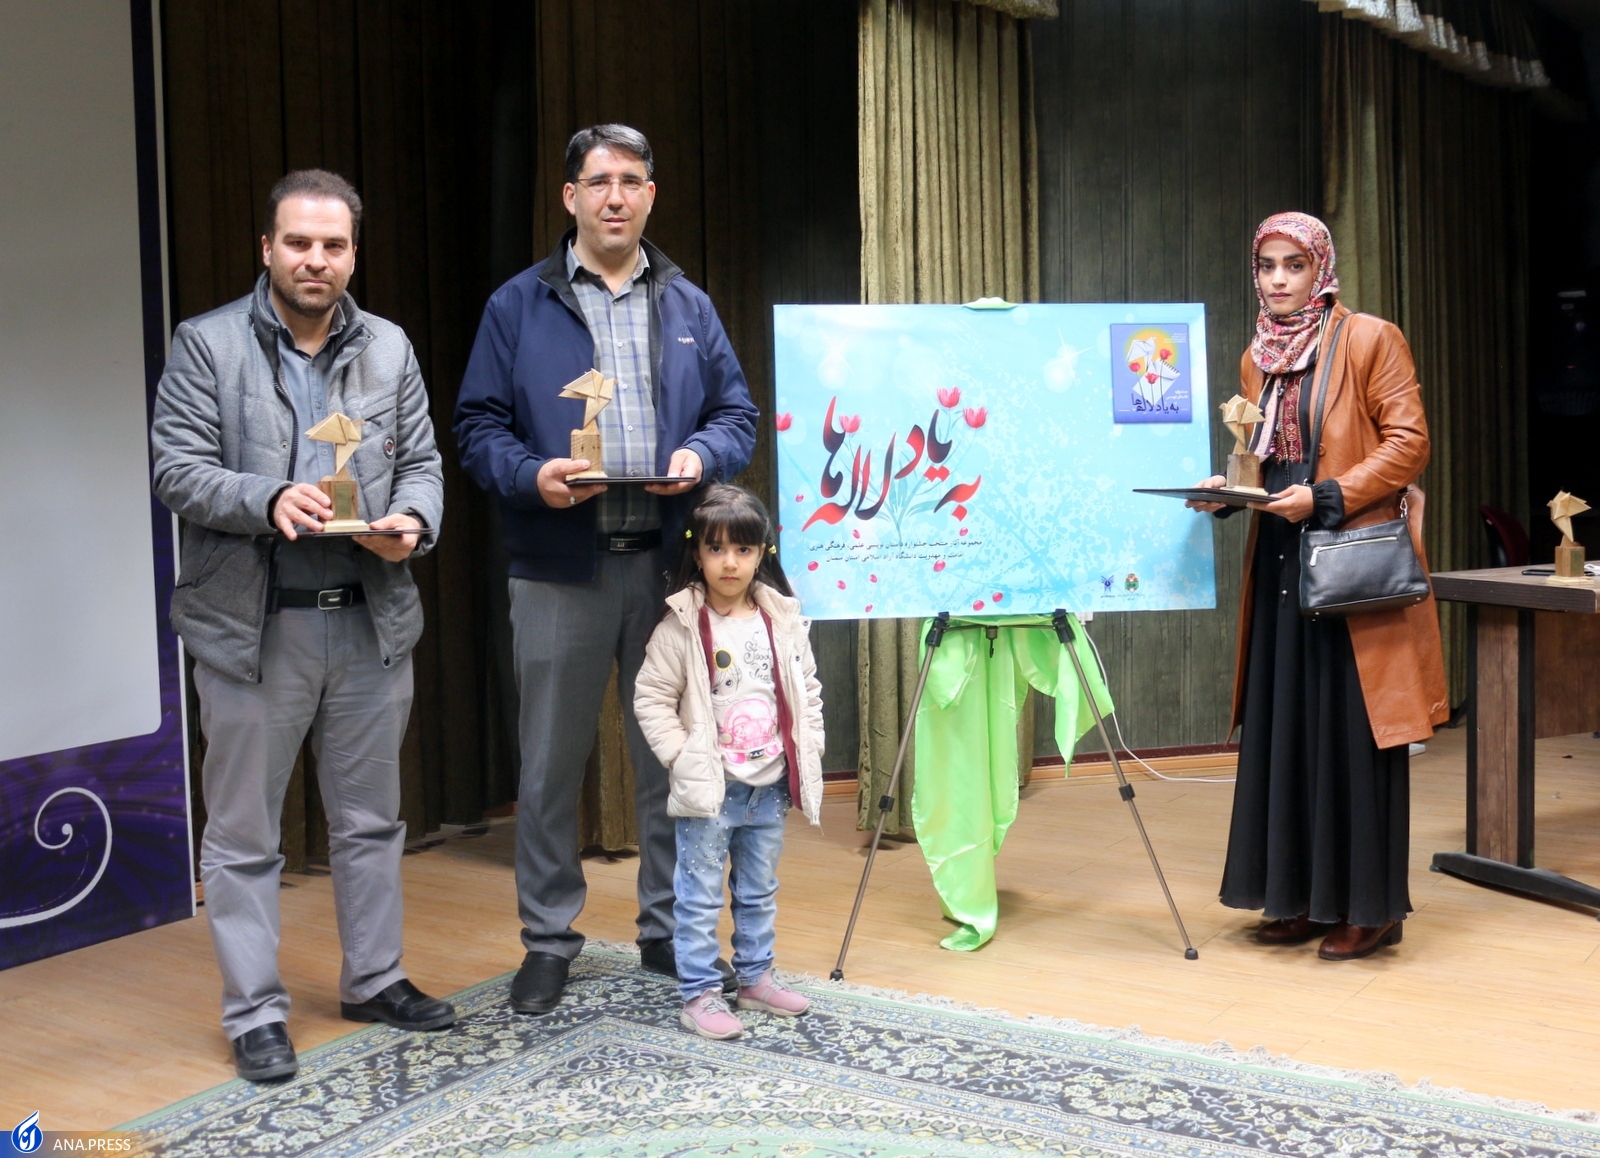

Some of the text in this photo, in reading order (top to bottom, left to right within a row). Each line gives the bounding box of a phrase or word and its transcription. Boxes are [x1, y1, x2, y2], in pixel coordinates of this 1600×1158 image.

[1169, 403, 1179, 414] به
[894, 408, 953, 483] یاد
[934, 474, 982, 522] به
[825, 540, 846, 551] فرهنگی
[866, 542, 884, 550] نویسی
[885, 541, 903, 549] داستان
[904, 541, 927, 549] جشنواره
[949, 538, 960, 547] آثار
[960, 540, 982, 548] مجموعه
[844, 554, 860, 562] استان
[861, 554, 881, 562] اسلامی
[883, 552, 894, 561] آزاد
[895, 551, 917, 559] دانشگاه
